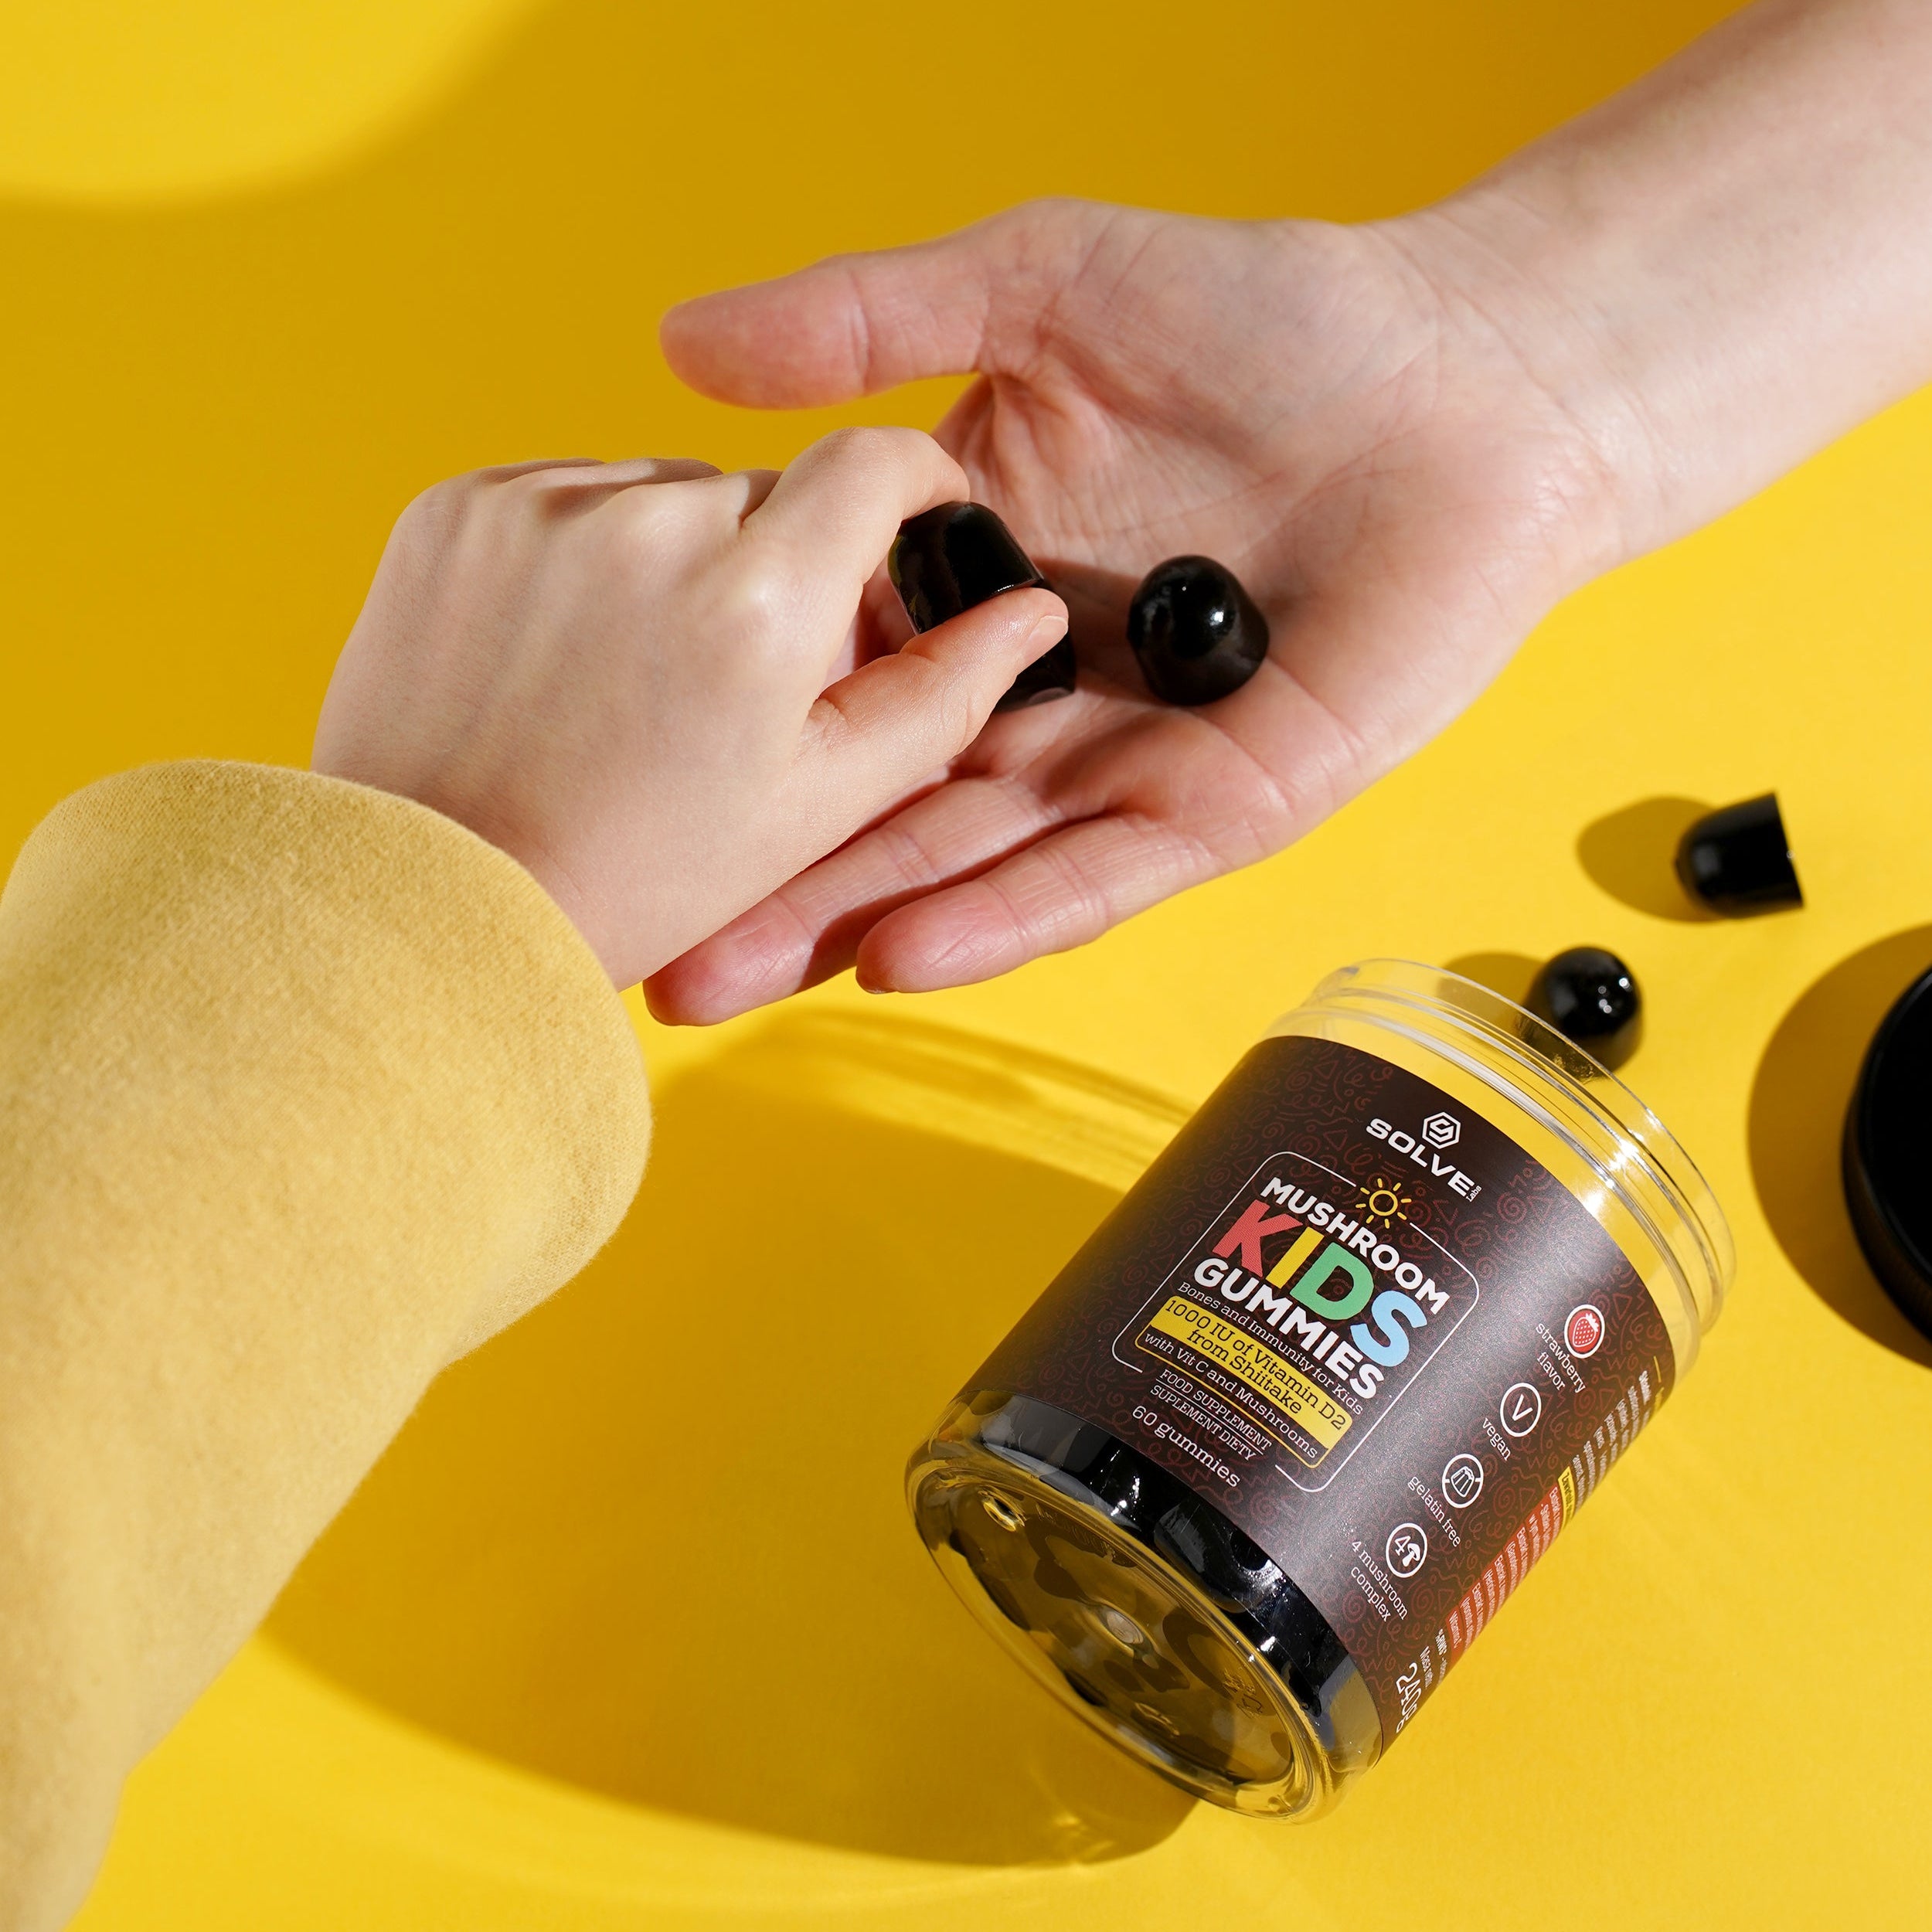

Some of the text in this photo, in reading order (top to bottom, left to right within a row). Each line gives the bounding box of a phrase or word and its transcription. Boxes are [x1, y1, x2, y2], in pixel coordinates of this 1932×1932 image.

[1366, 1118, 1475, 1197] SOLVE
[1465, 1185, 1482, 1202] Labs
[1212, 1199, 1428, 1367] KIDS
[1260, 1177, 1451, 1315] MUSHROOM
[1165, 1300, 1346, 1430] 1000 IU of Vitamin D2
[1177, 1282, 1363, 1415] Bones and Immunity for Kids
[1194, 1258, 1385, 1399] GUMMIES
[1536, 1323, 1587, 1393] strawberry
[1145, 1333, 1318, 1459] with Vit C and Mushrooms
[1159, 1369, 1272, 1451] FOOD SUPPLEMENT
[1187, 1329, 1302, 1414] from Shiitake
[1536, 1352, 1566, 1391] flavor
[1132, 1405, 1240, 1488] 60 gummies
[1150, 1385, 1257, 1461] SUPLEMENT DIETY
[1481, 1417, 1511, 1461] vegan
[1407, 1476, 1462, 1547] gelatin free
[1350, 1566, 1393, 1622] complex
[1352, 1540, 1409, 1620] 4 mushroom
